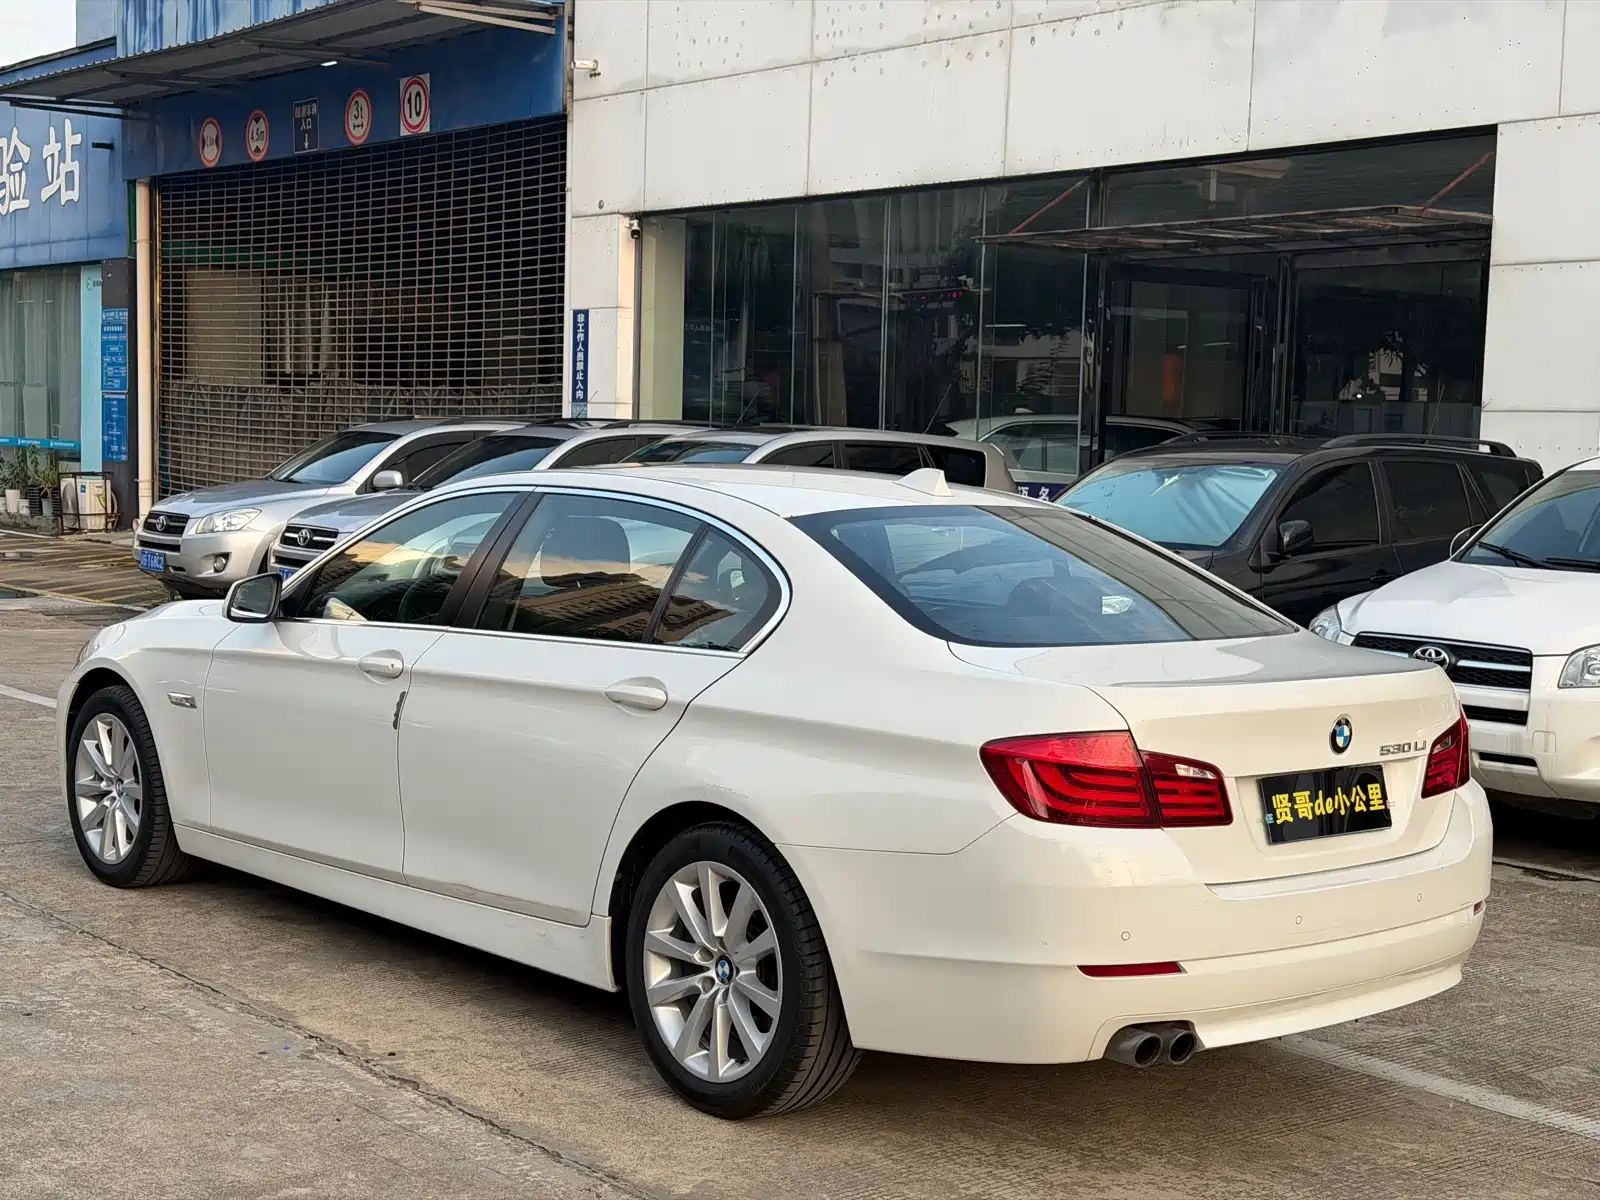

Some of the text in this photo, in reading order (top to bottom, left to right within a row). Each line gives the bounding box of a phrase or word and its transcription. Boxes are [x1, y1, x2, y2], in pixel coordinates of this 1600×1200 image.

[353, 99, 364, 120] 3t
[407, 91, 422, 119] 10
[300, 118, 312, 131] 入口
[0, 118, 82, 216] 验站
[575, 313, 586, 400] 非工作人员禁止入内
[1379, 741, 1412, 756] 530
[1272, 783, 1386, 825] 贤哥de小公里
